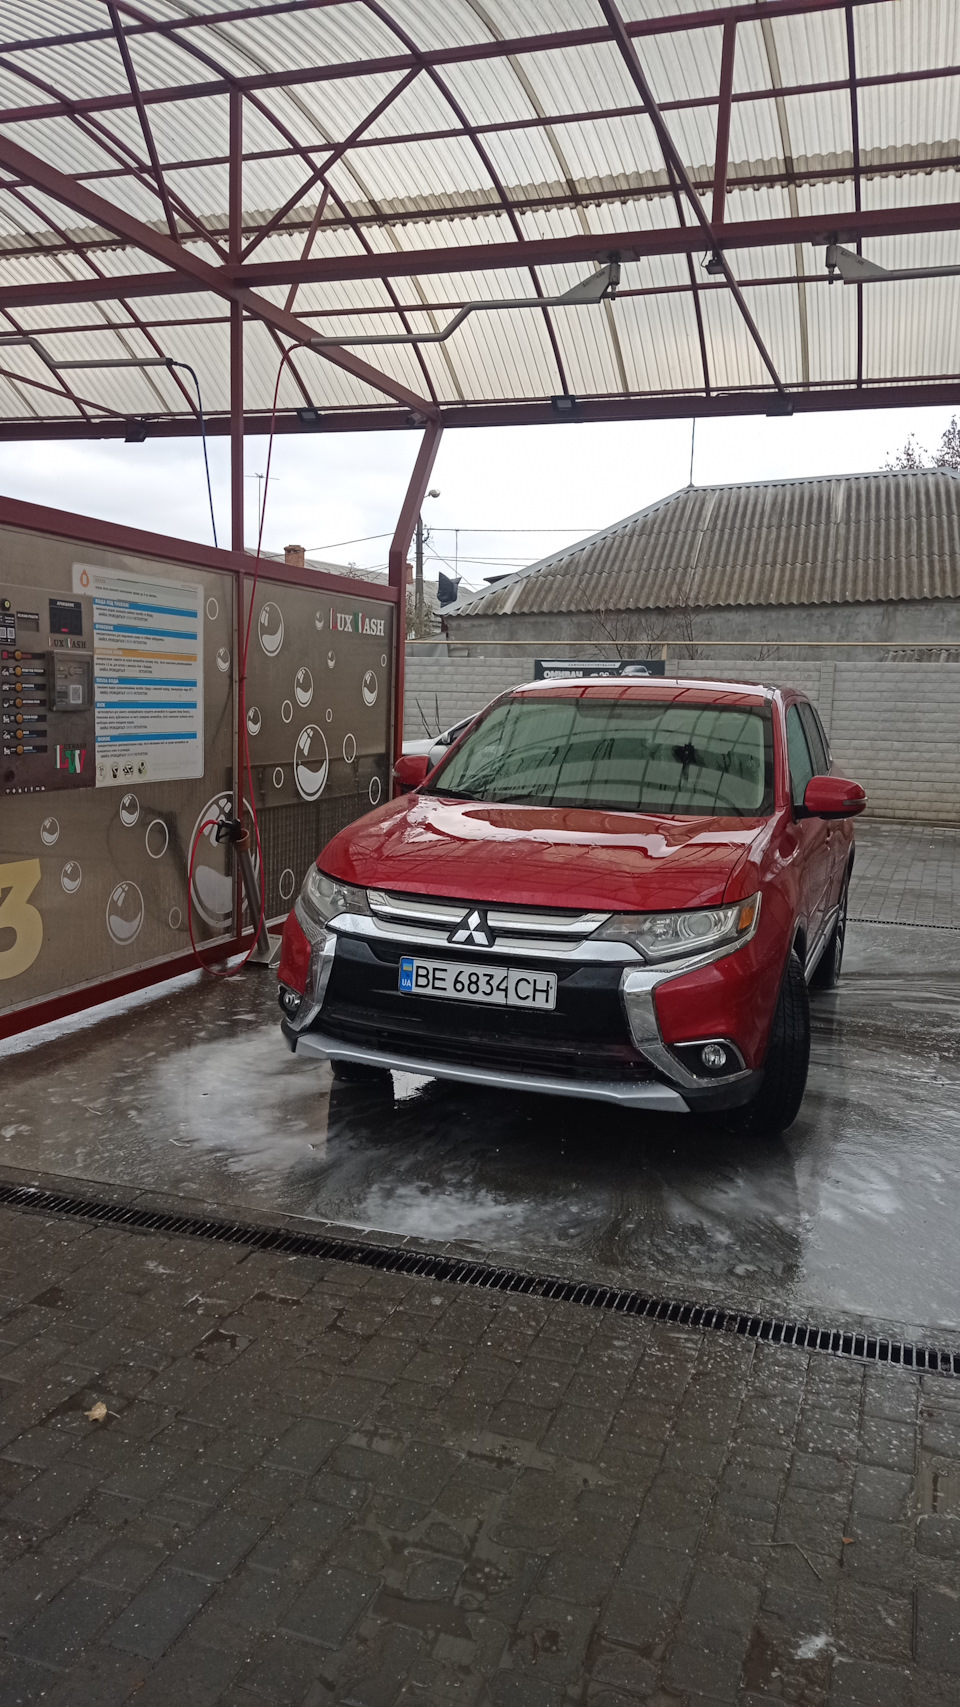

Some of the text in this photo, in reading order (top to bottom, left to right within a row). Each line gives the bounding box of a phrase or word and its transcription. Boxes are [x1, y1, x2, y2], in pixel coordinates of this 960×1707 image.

[329, 608, 385, 636] LUX WASH
[401, 978, 412, 987] UA
[415, 965, 550, 1003] BE 6834 CH
